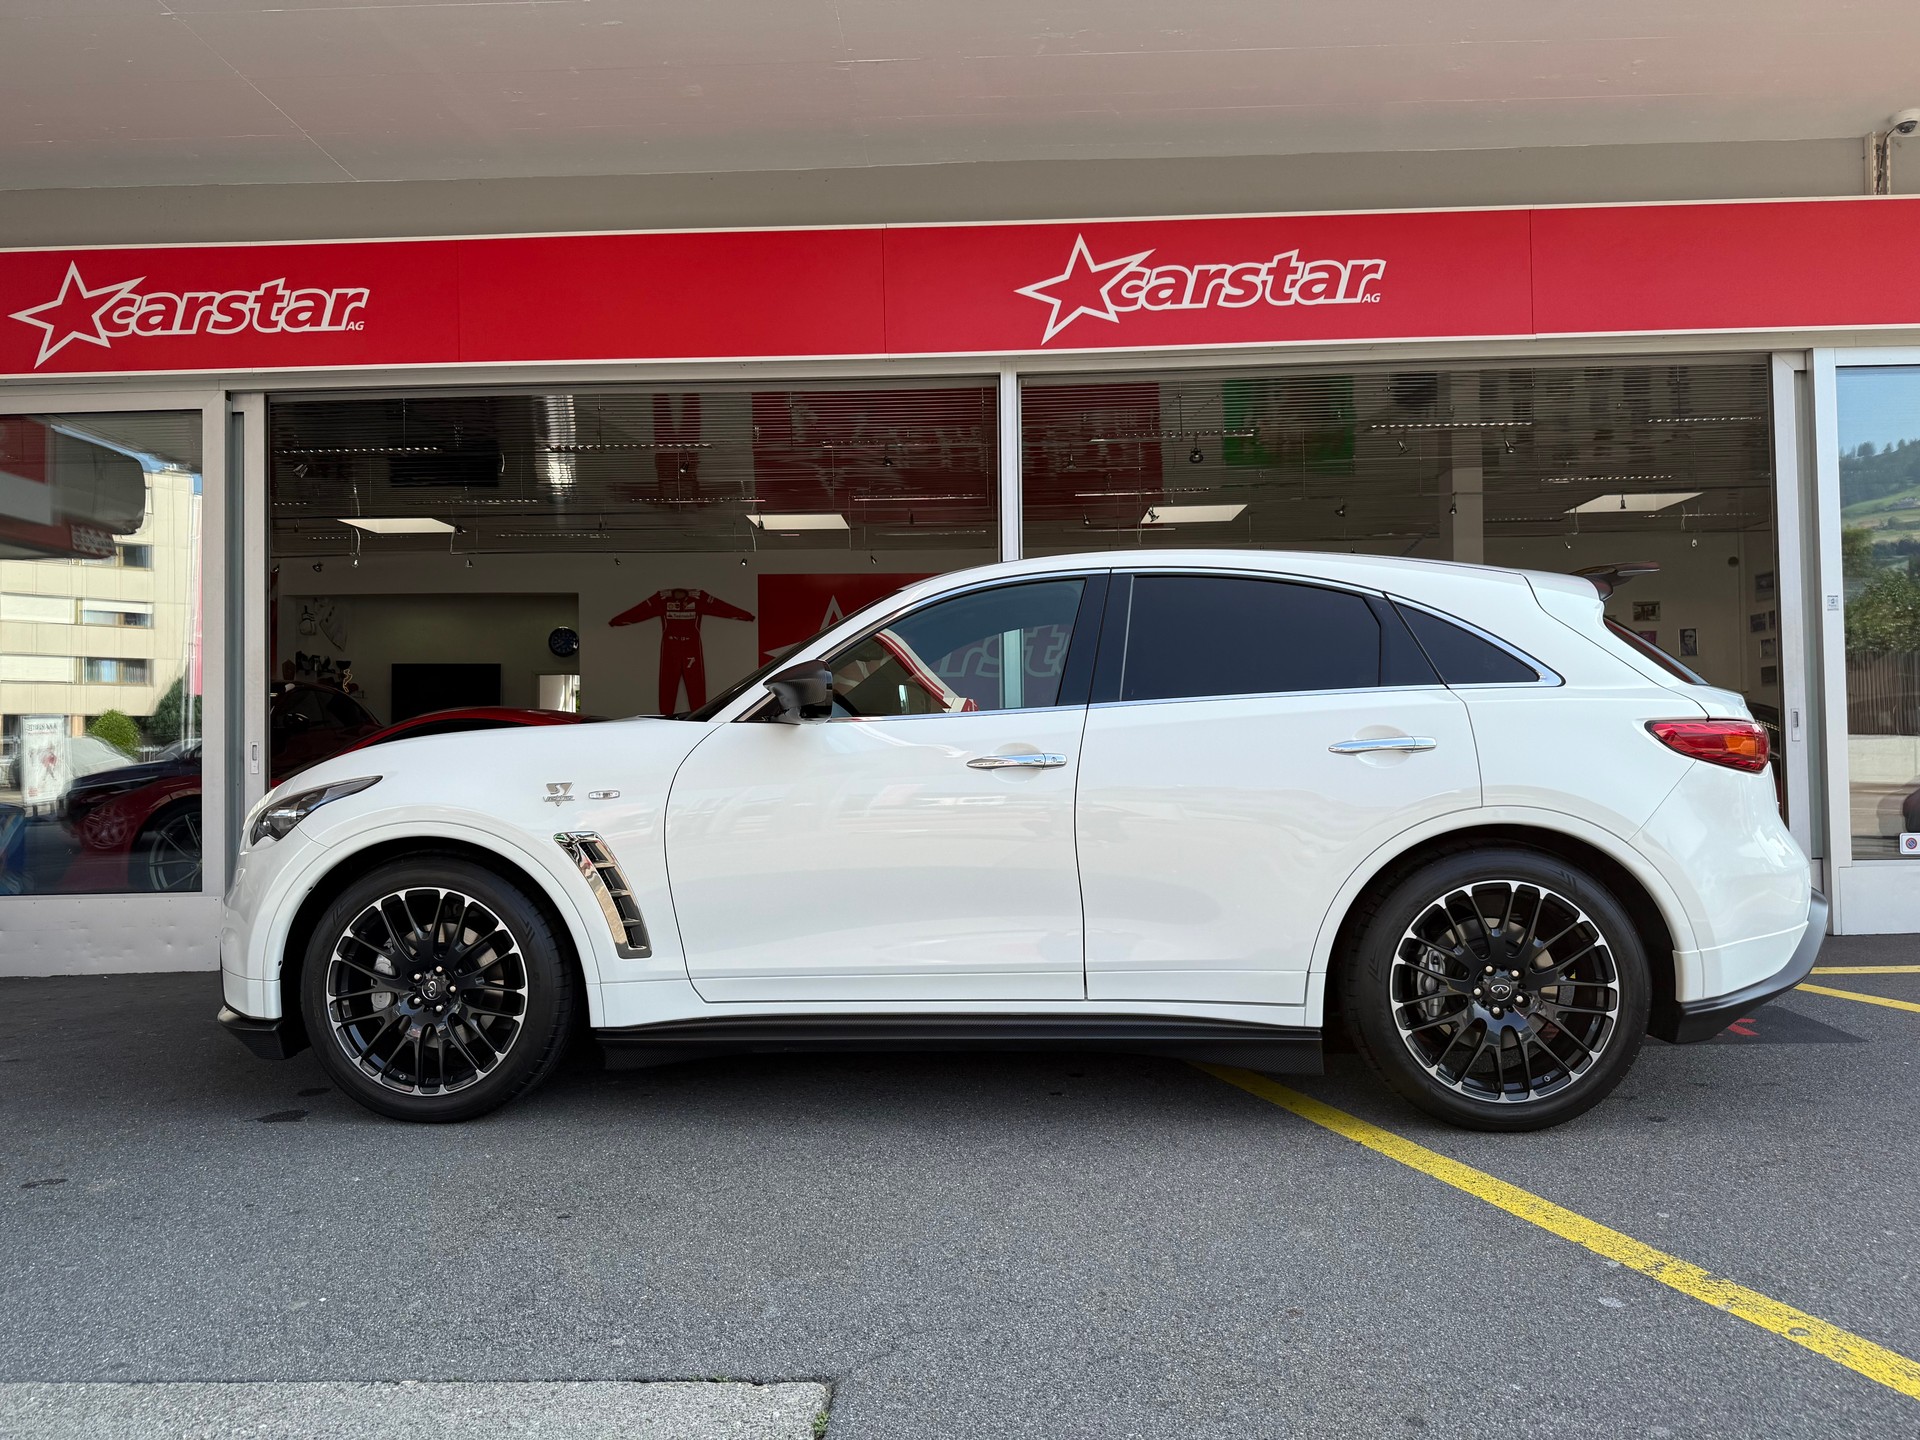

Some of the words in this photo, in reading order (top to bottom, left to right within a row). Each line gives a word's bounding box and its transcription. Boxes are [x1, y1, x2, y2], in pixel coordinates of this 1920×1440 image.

[1101, 248, 1387, 313] carstar
[1361, 293, 1381, 303] AG
[98, 276, 370, 338] carstar
[345, 321, 365, 331] AG
[687, 657, 696, 669] 7
